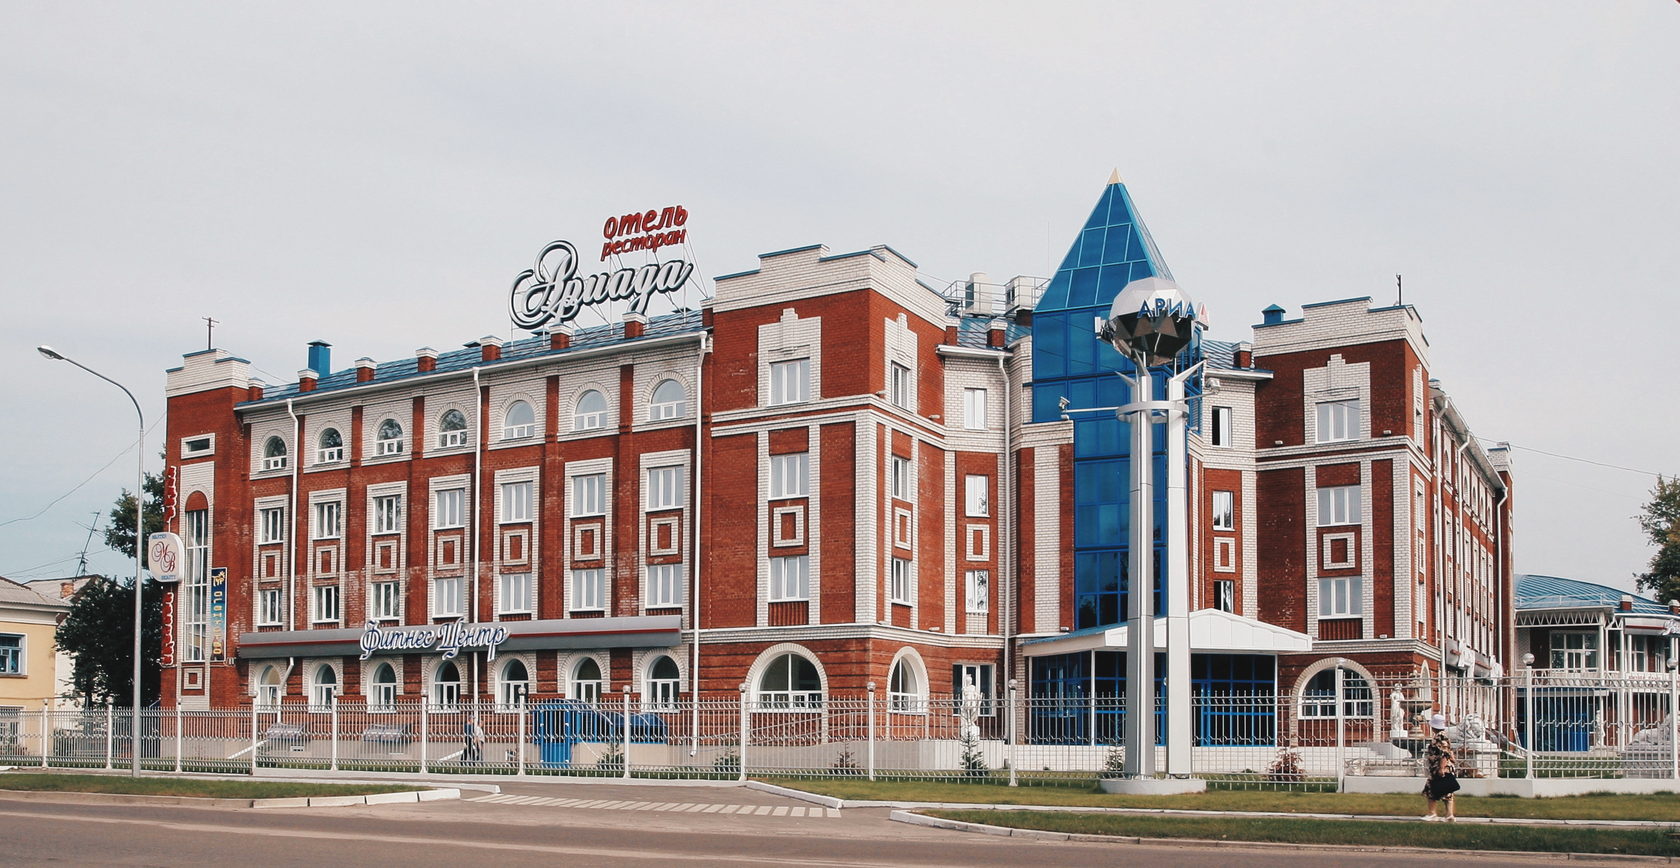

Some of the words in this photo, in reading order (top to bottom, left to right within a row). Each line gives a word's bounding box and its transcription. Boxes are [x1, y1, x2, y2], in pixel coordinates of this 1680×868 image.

[600, 229, 687, 262] ресторан
[508, 240, 694, 329] Ариада
[360, 619, 435, 660] Фитнес
[436, 617, 509, 662] Центр
